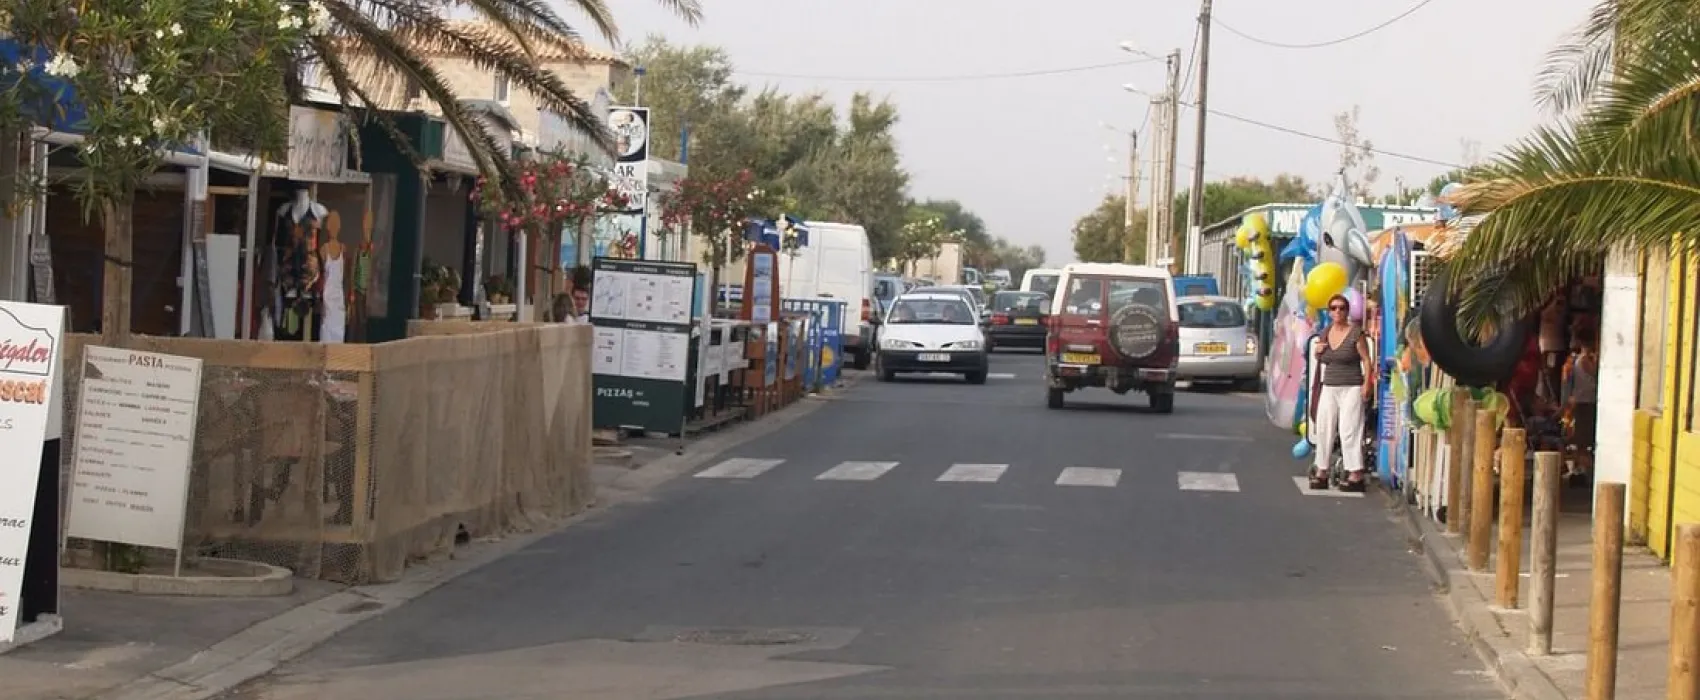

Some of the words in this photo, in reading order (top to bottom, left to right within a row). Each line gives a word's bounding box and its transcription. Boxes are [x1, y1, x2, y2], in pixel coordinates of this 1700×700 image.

[611, 165, 635, 177] AR
[129, 354, 164, 369] PASTA
[0, 379, 46, 405] scat
